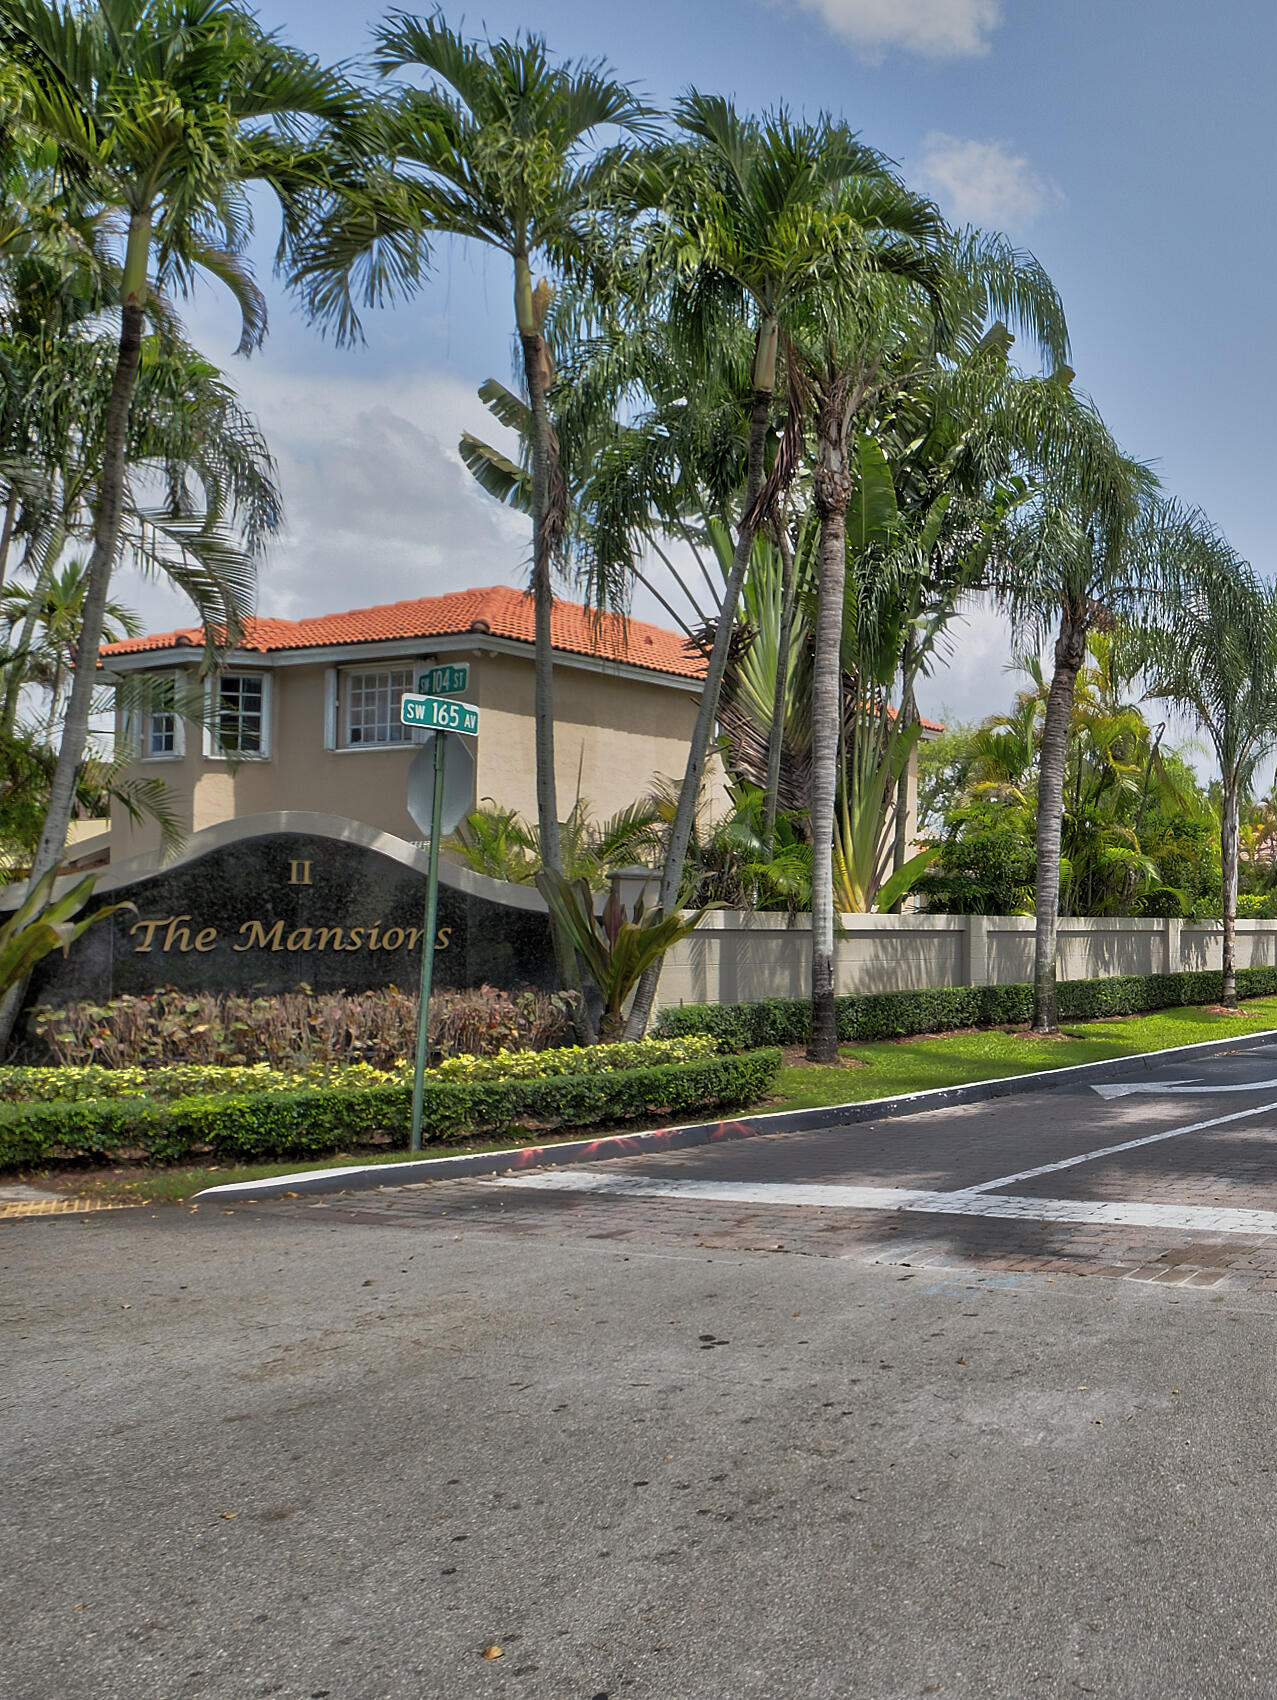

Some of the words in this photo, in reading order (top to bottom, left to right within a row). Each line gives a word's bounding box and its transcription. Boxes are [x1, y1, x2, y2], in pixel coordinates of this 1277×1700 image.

[432, 669, 450, 693] 104
[453, 672, 464, 688] ST
[406, 703, 425, 720] SW
[432, 702, 459, 727] 165
[464, 714, 476, 729] AV
[287, 859, 313, 885] II
[129, 914, 218, 952] The
